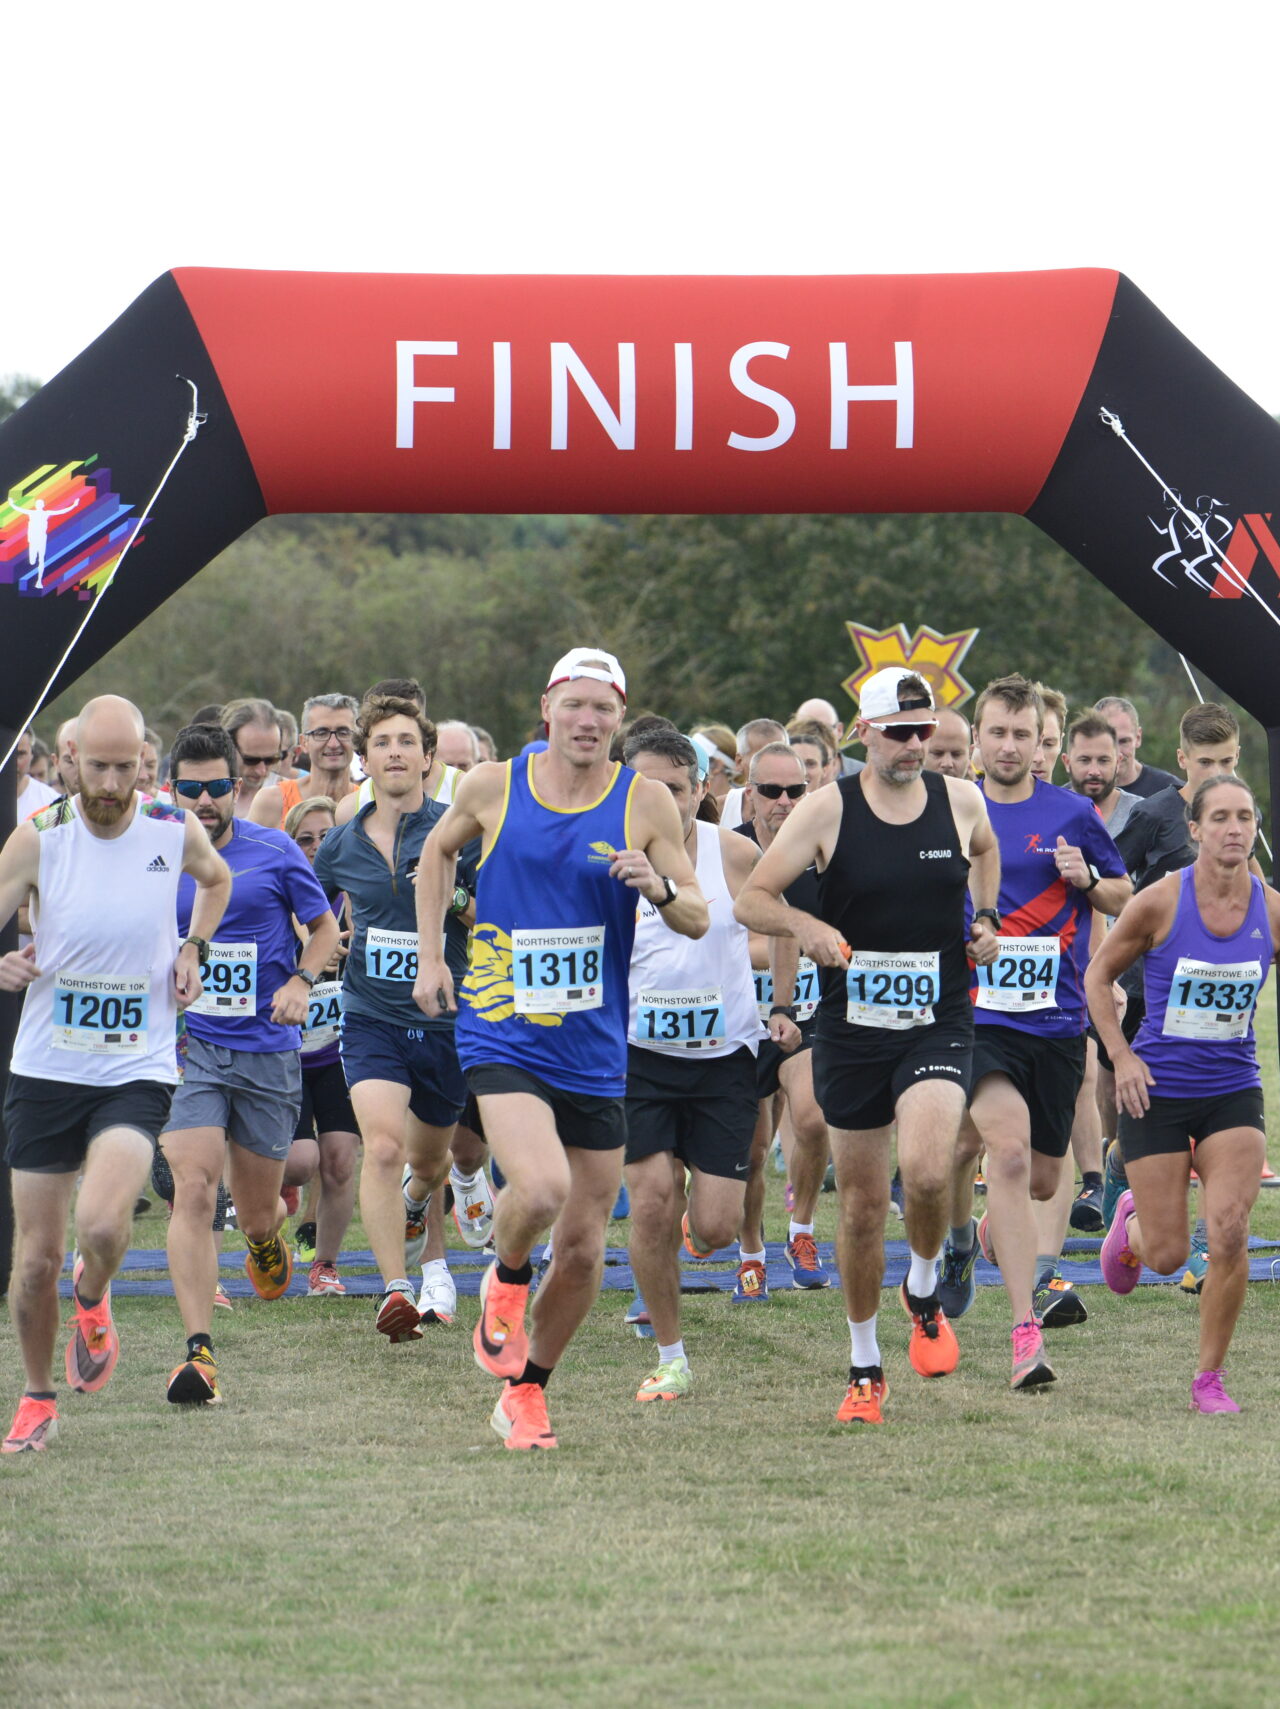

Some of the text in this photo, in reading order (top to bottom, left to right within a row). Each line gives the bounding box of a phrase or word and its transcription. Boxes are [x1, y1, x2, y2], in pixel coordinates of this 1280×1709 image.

[396, 340, 914, 452] FINISH
[919, 850, 952, 860] C-SQUAD
[517, 935, 601, 946] NORTHSTOWE 10K
[199, 962, 251, 993] 293
[370, 949, 419, 981] 128
[519, 950, 599, 987] 1318
[854, 959, 935, 968] NORTHSTOWE 10K
[986, 958, 1054, 988] 1284
[1180, 965, 1242, 978] NORTHSTOWE
[59, 977, 145, 991] NORTHSTOWE 10K
[642, 993, 718, 1005] NORTHSTOWE 10K
[853, 973, 935, 1007] 1299
[1178, 980, 1255, 1011] 1333
[60, 993, 143, 1030] 1205
[643, 1008, 719, 1039] 1317
